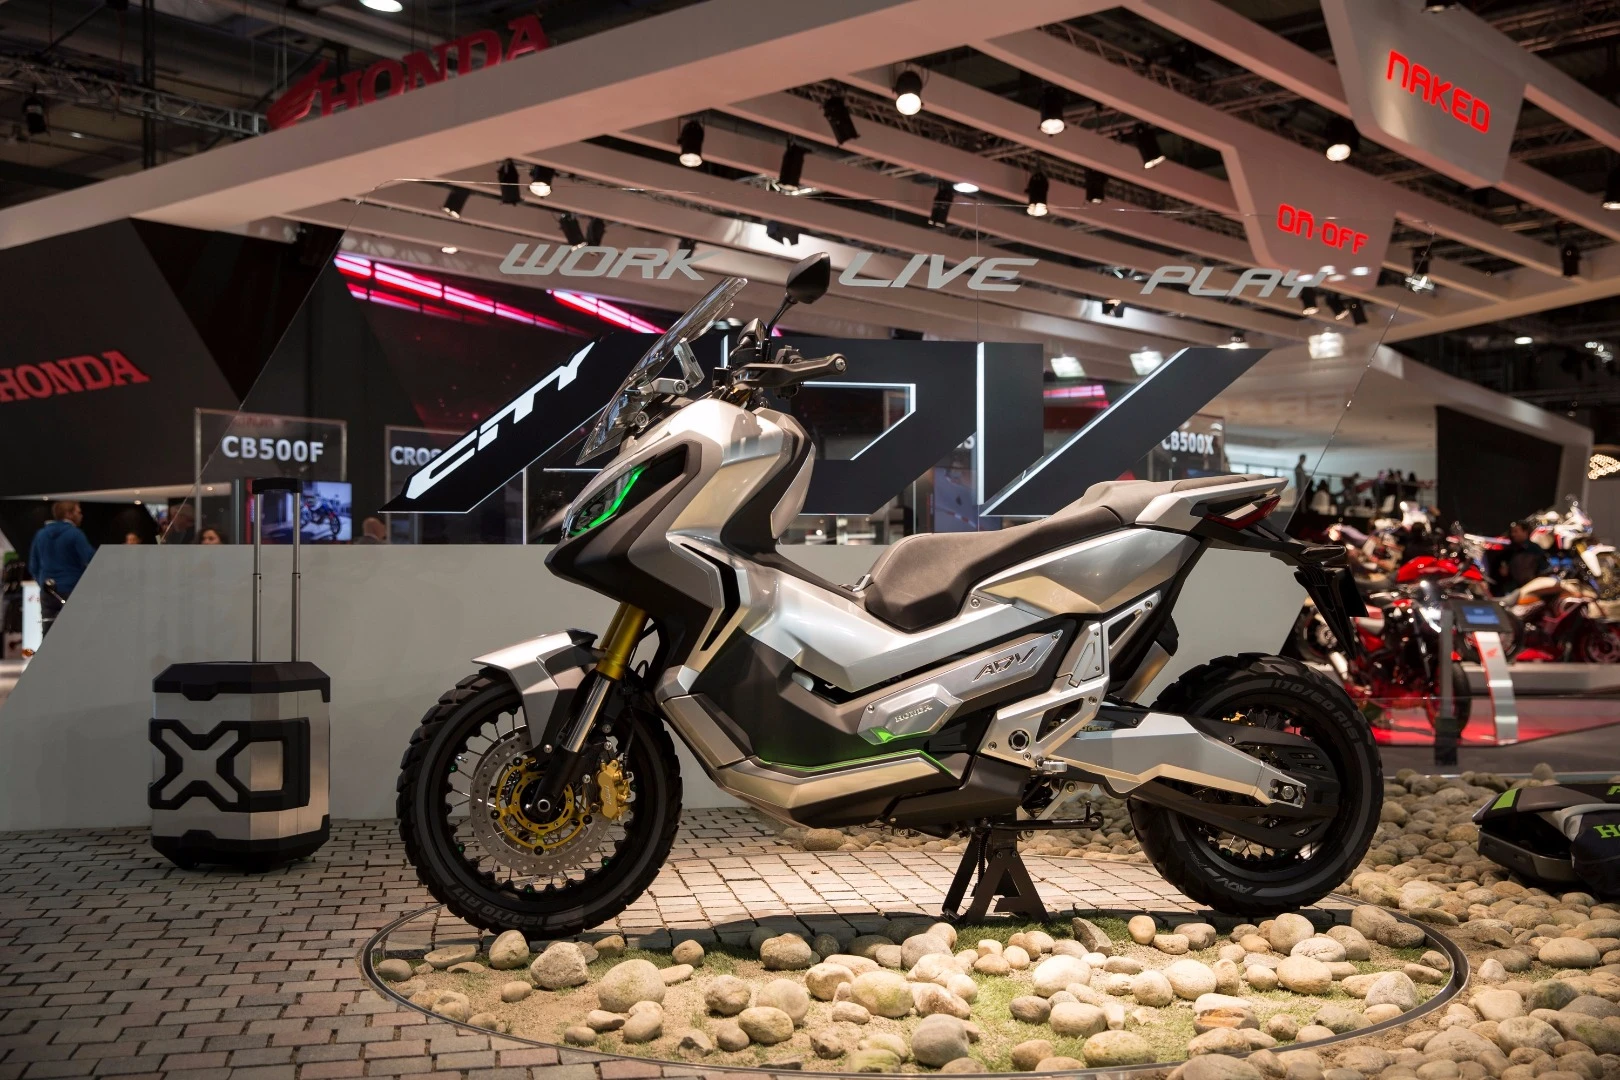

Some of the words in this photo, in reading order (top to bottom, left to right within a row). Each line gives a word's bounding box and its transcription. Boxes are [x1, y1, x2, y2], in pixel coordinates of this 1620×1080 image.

[316, 14, 549, 117] HONDA
[1386, 49, 1491, 133] NAKED
[499, 242, 728, 281] WORK
[838, 252, 1039, 292] LIVE
[1140, 264, 1328, 299] PLAY
[0, 350, 150, 402] HONDA
[221, 435, 324, 463] CB500F
[971, 645, 1038, 683] ADV
[894, 704, 934, 723] HONDA
